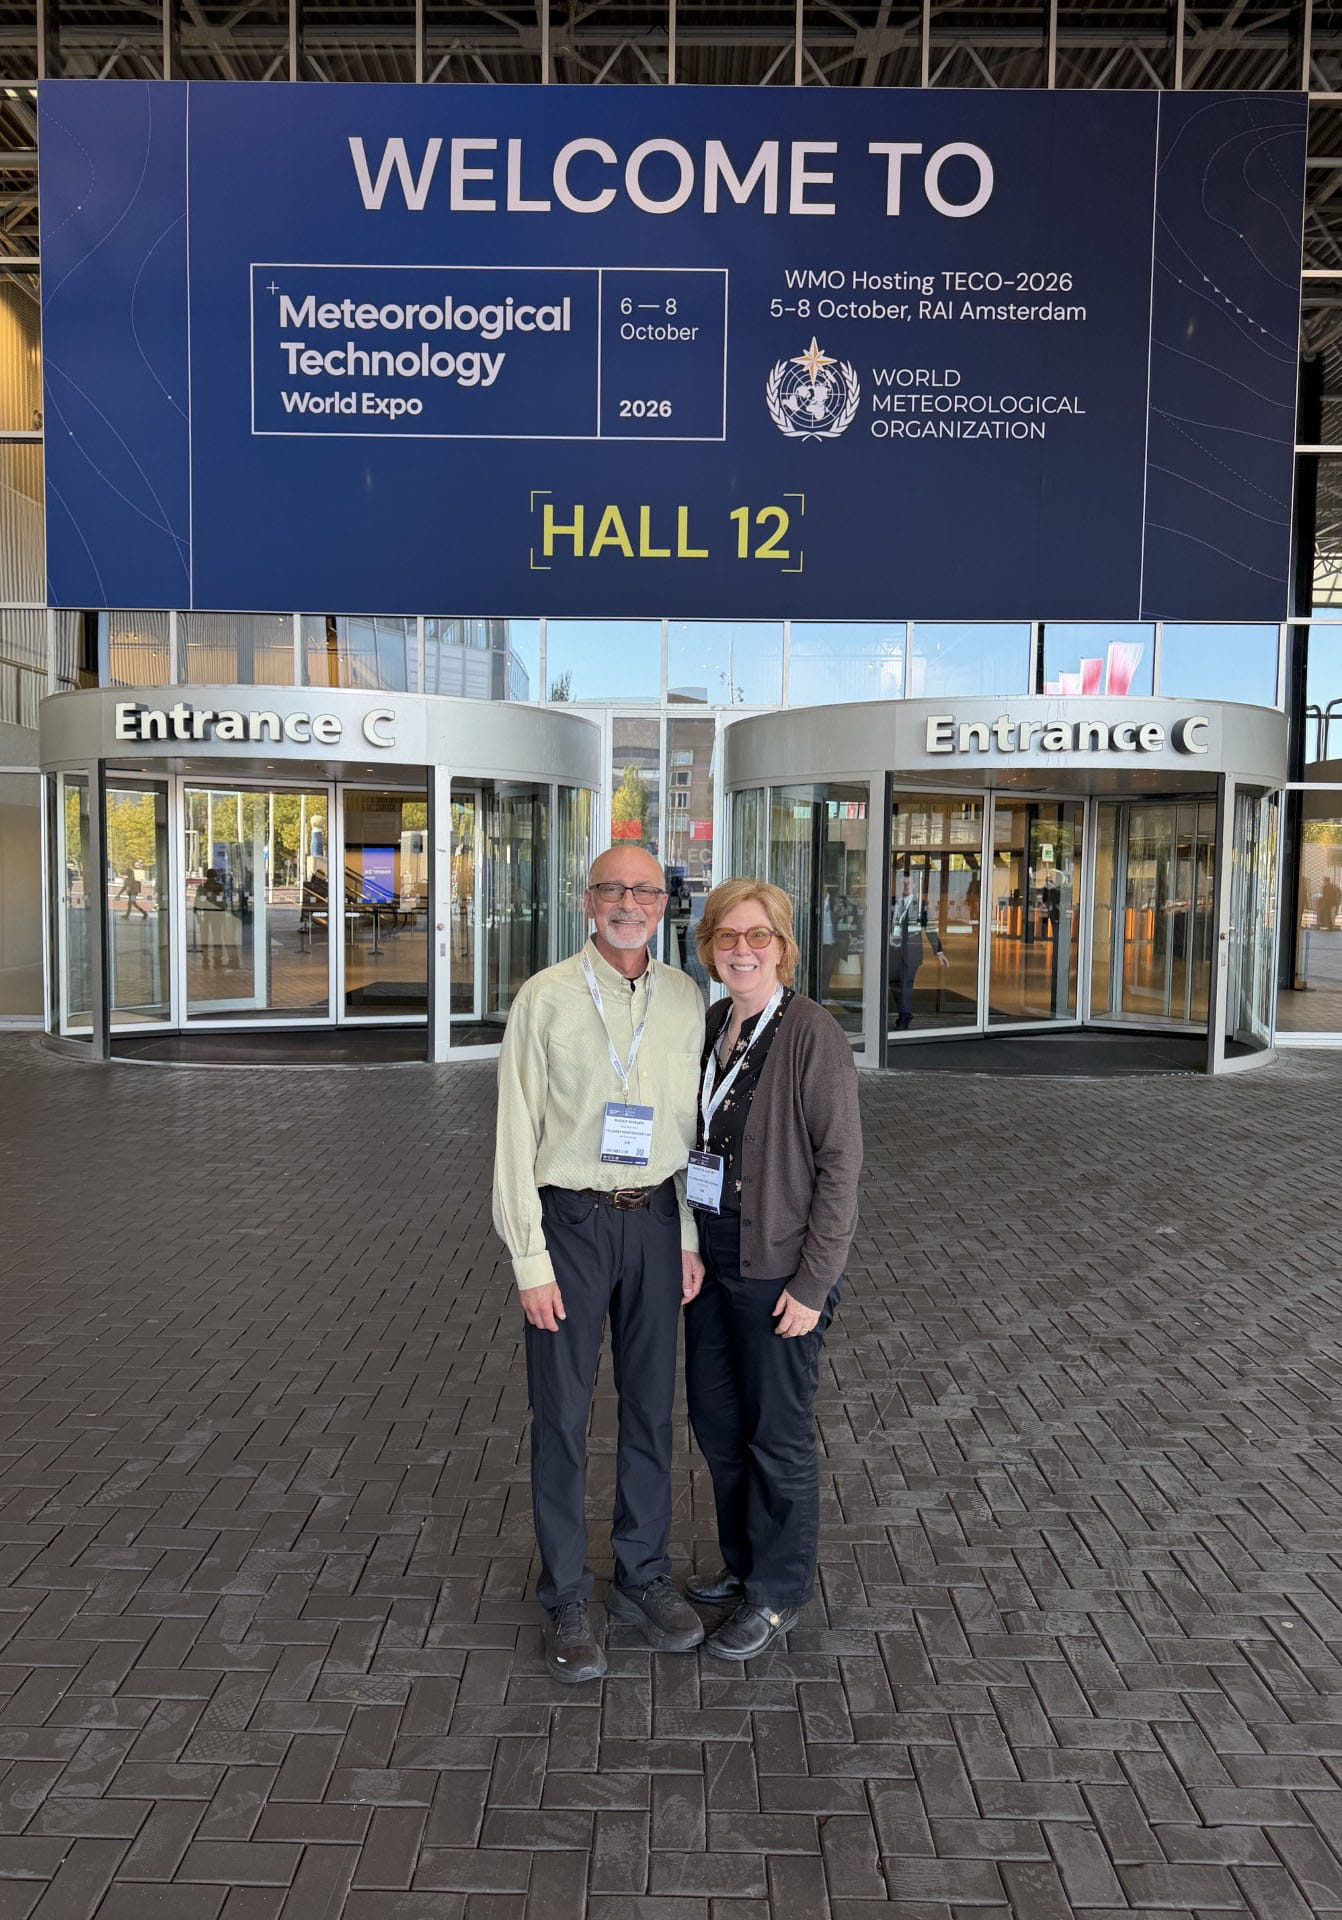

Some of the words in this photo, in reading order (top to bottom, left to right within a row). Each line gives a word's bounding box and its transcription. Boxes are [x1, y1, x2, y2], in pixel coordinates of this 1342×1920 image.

[349, 136, 838, 216] WELCOME
[868, 142, 994, 218] TO
[785, 269, 845, 290] WMO
[853, 270, 935, 296] Hosting
[942, 271, 1073, 292] TECO-2026
[279, 295, 571, 341] Meteorological
[620, 297, 632, 315] 6
[665, 297, 677, 315] 8
[770, 298, 810, 318] 5-8
[817, 299, 912, 323] October,
[919, 300, 953, 320] RAI
[960, 301, 1087, 321] Amsterdam
[620, 322, 699, 341] October
[280, 341, 506, 387] Technology
[872, 368, 961, 387] WORLD
[281, 391, 357, 414] World
[361, 392, 423, 420] Expo
[619, 399, 672, 418] 2026
[872, 394, 1086, 414] METEOROLOGICAL
[871, 420, 1046, 439] ORGANIZATION
[543, 504, 709, 558] HALL
[730, 506, 790, 559] 12
[115, 701, 343, 745] Entrance
[362, 708, 396, 747] C
[926, 713, 1166, 753] Entrance
[1172, 716, 1209, 755] C
